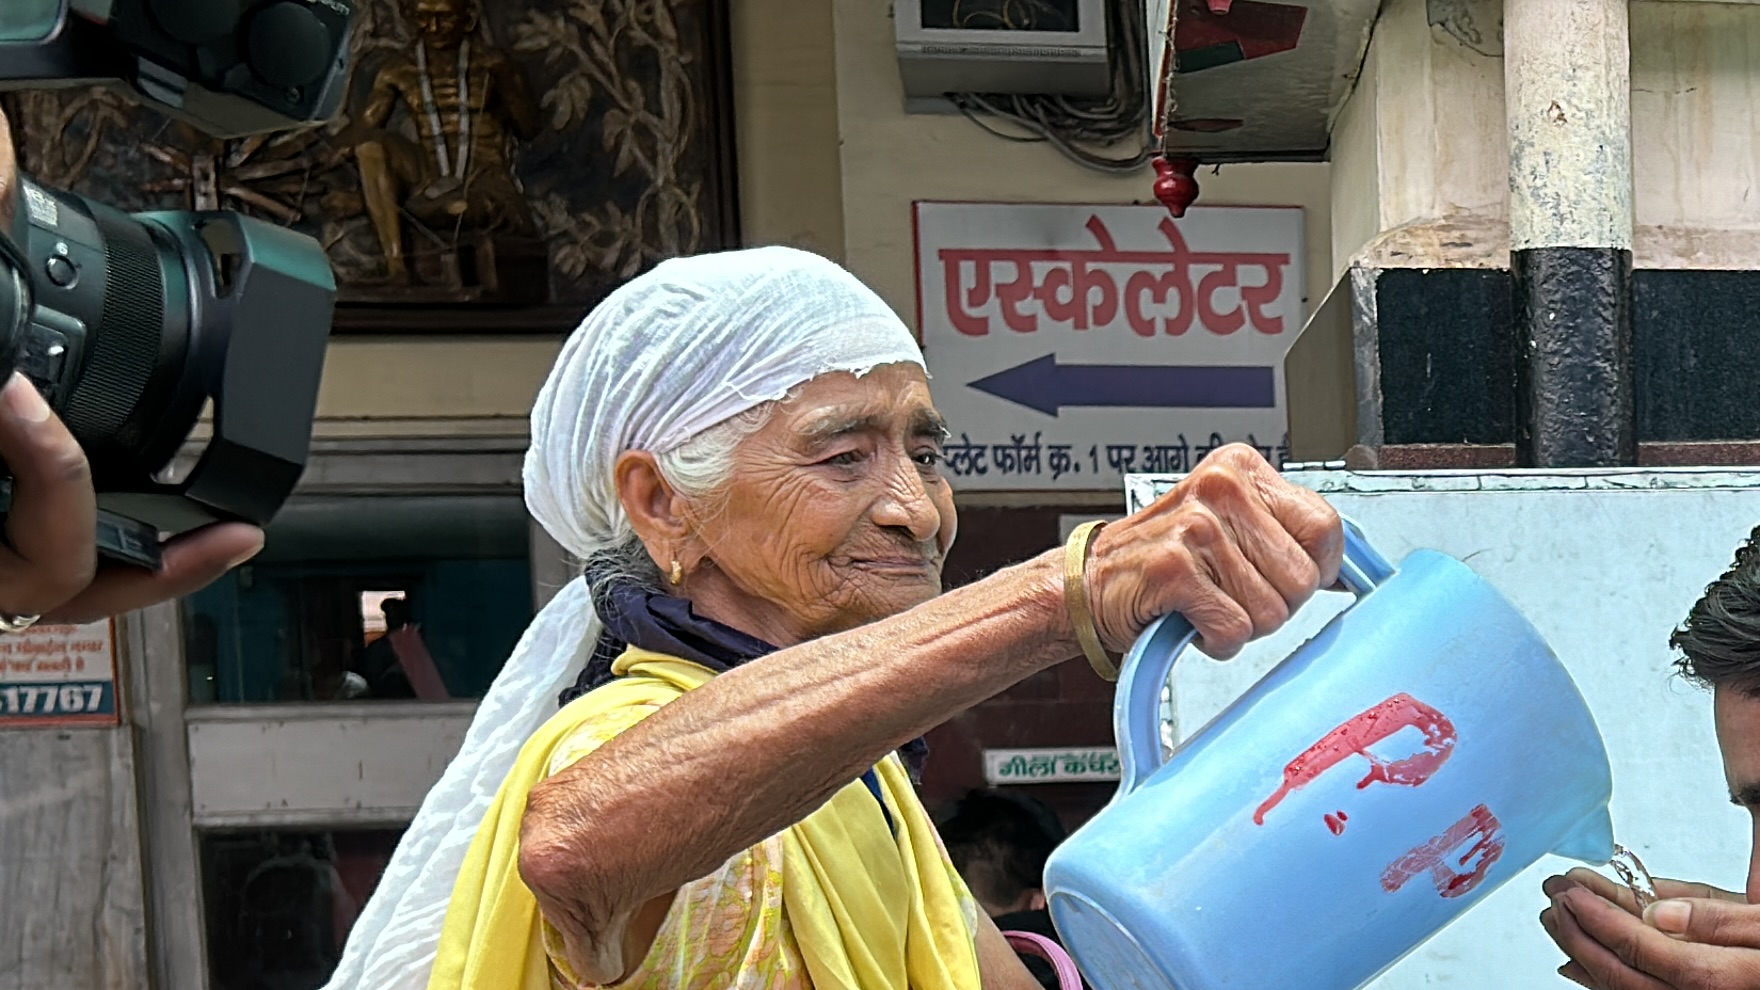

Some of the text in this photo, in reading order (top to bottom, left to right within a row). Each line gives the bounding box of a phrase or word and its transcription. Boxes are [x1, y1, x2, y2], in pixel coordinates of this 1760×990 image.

[938, 214, 1290, 337] एस्केलेटर
[993, 430, 1042, 475] फॉर्म
[1088, 444, 1099, 474] 1
[1106, 444, 1138, 474] पर
[1141, 432, 1189, 473] आगे
[0, 684, 103, 713] 17767
